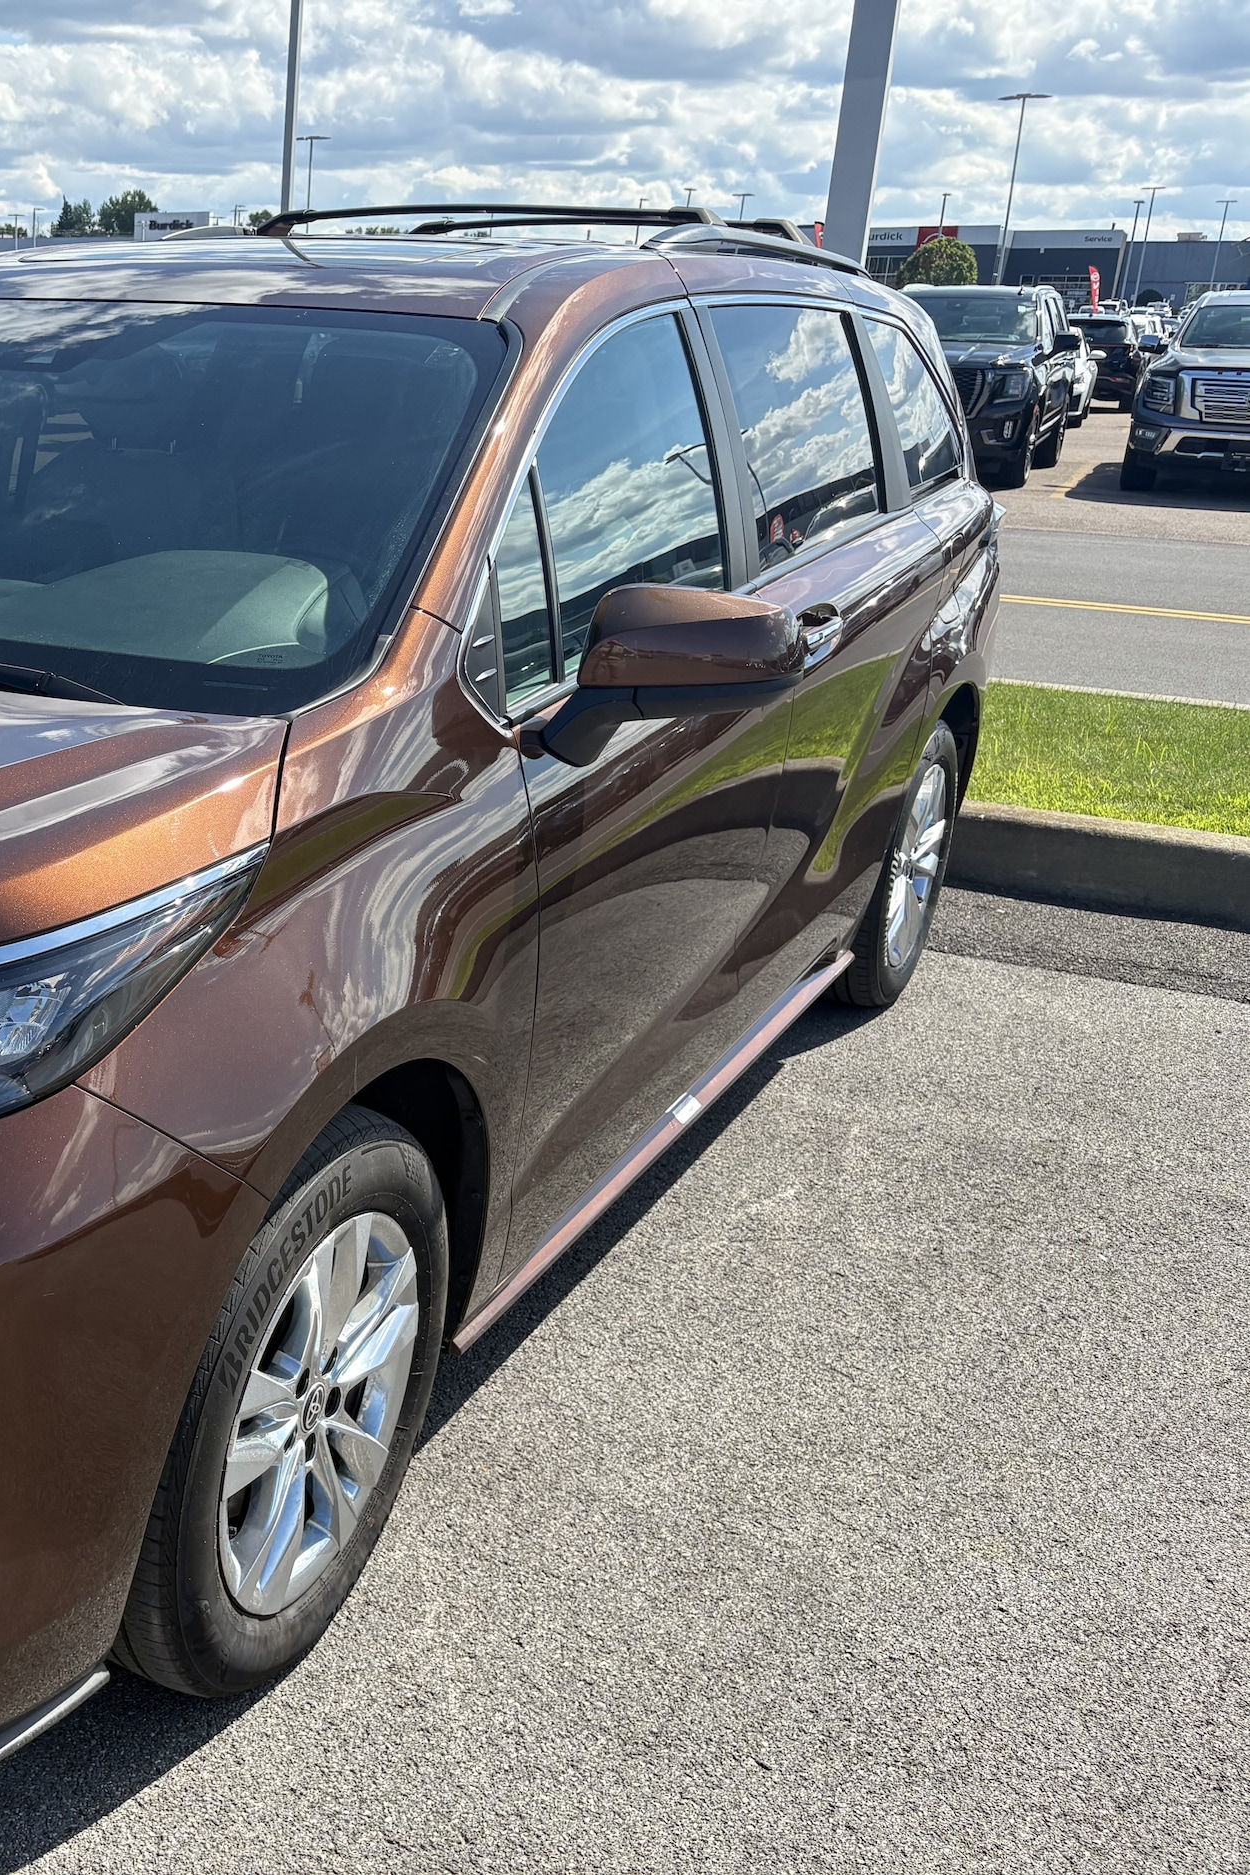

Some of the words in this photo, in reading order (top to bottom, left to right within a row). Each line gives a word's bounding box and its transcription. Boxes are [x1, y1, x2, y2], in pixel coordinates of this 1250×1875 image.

[149, 220, 194, 230] Burdick
[869, 232, 903, 241] urdick
[218, 1164, 353, 1397] BRIDGESTONE
